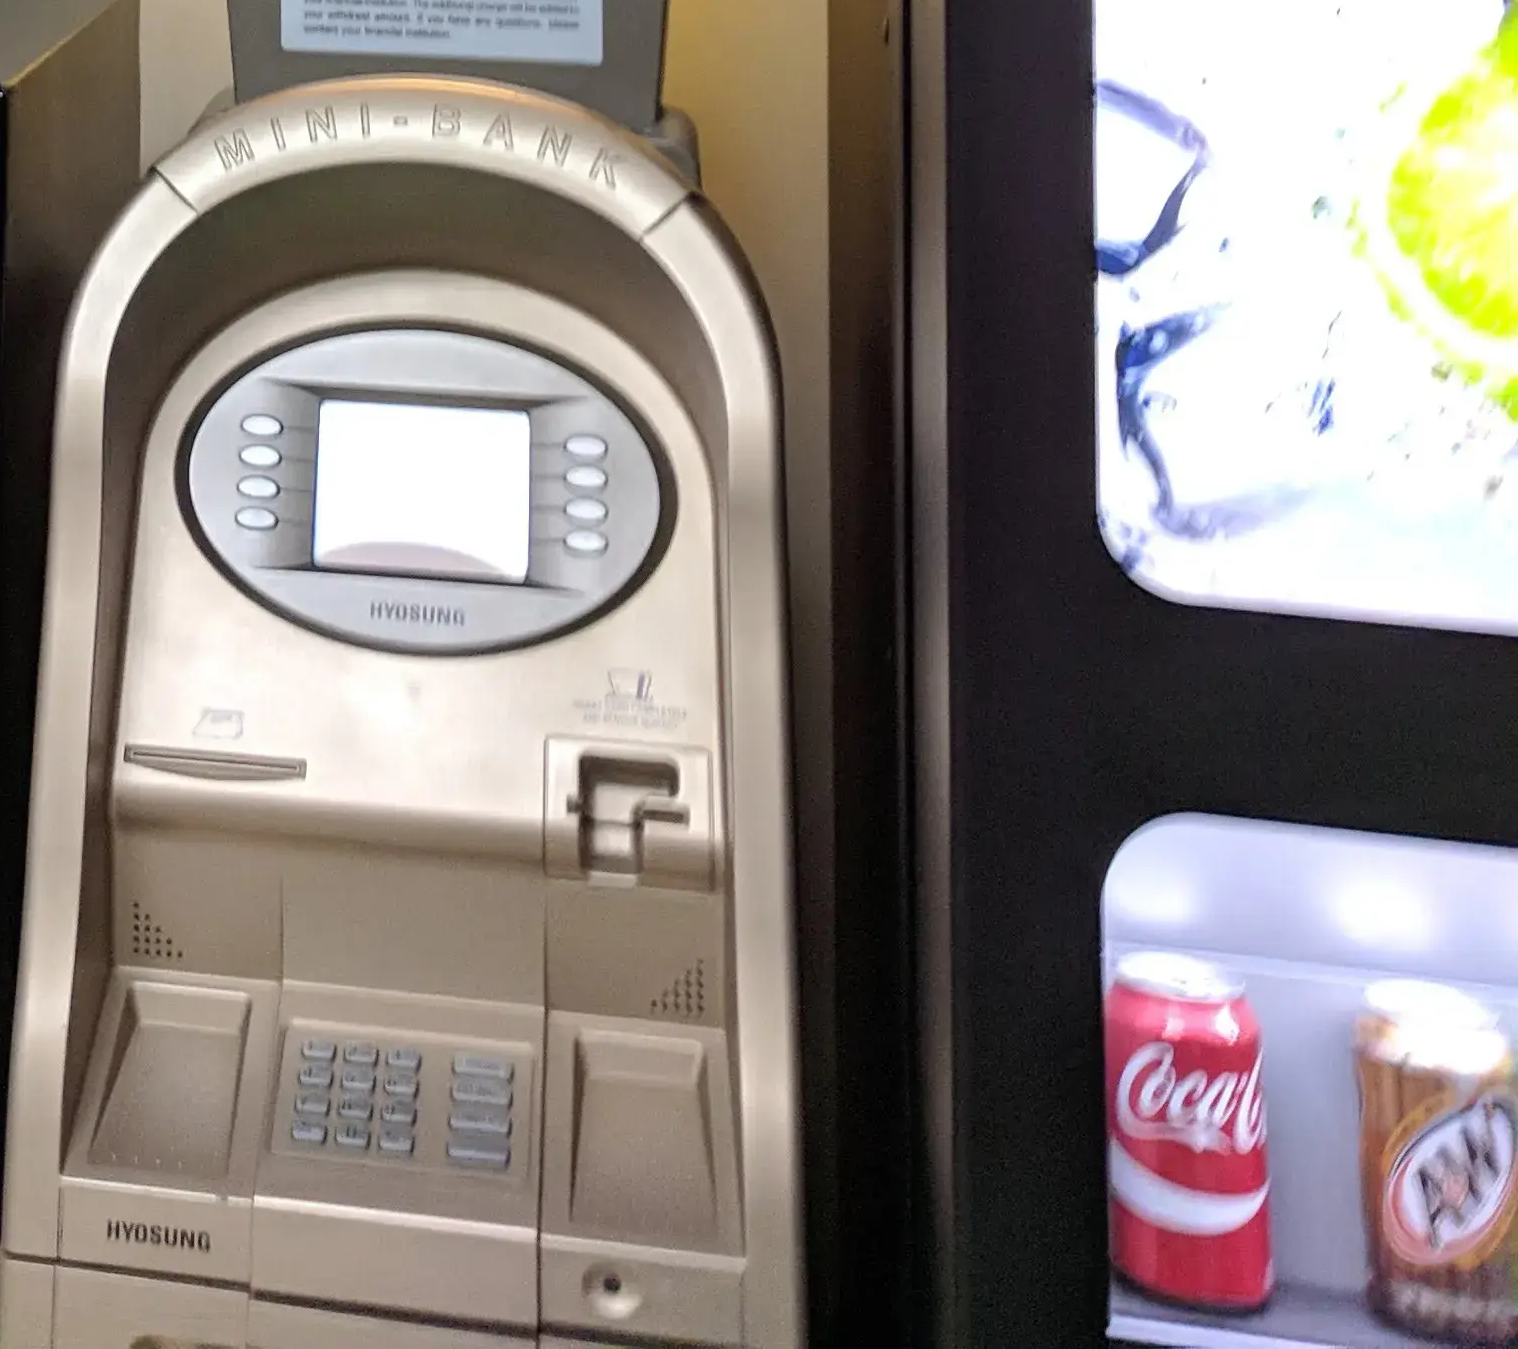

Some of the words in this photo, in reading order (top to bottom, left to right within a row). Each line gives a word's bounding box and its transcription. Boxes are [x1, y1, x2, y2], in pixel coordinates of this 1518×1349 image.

[213, 102, 623, 191] MINI-BANK
[369, 601, 466, 628] HYOSUNG
[106, 1219, 212, 1255] HYOSUNG
